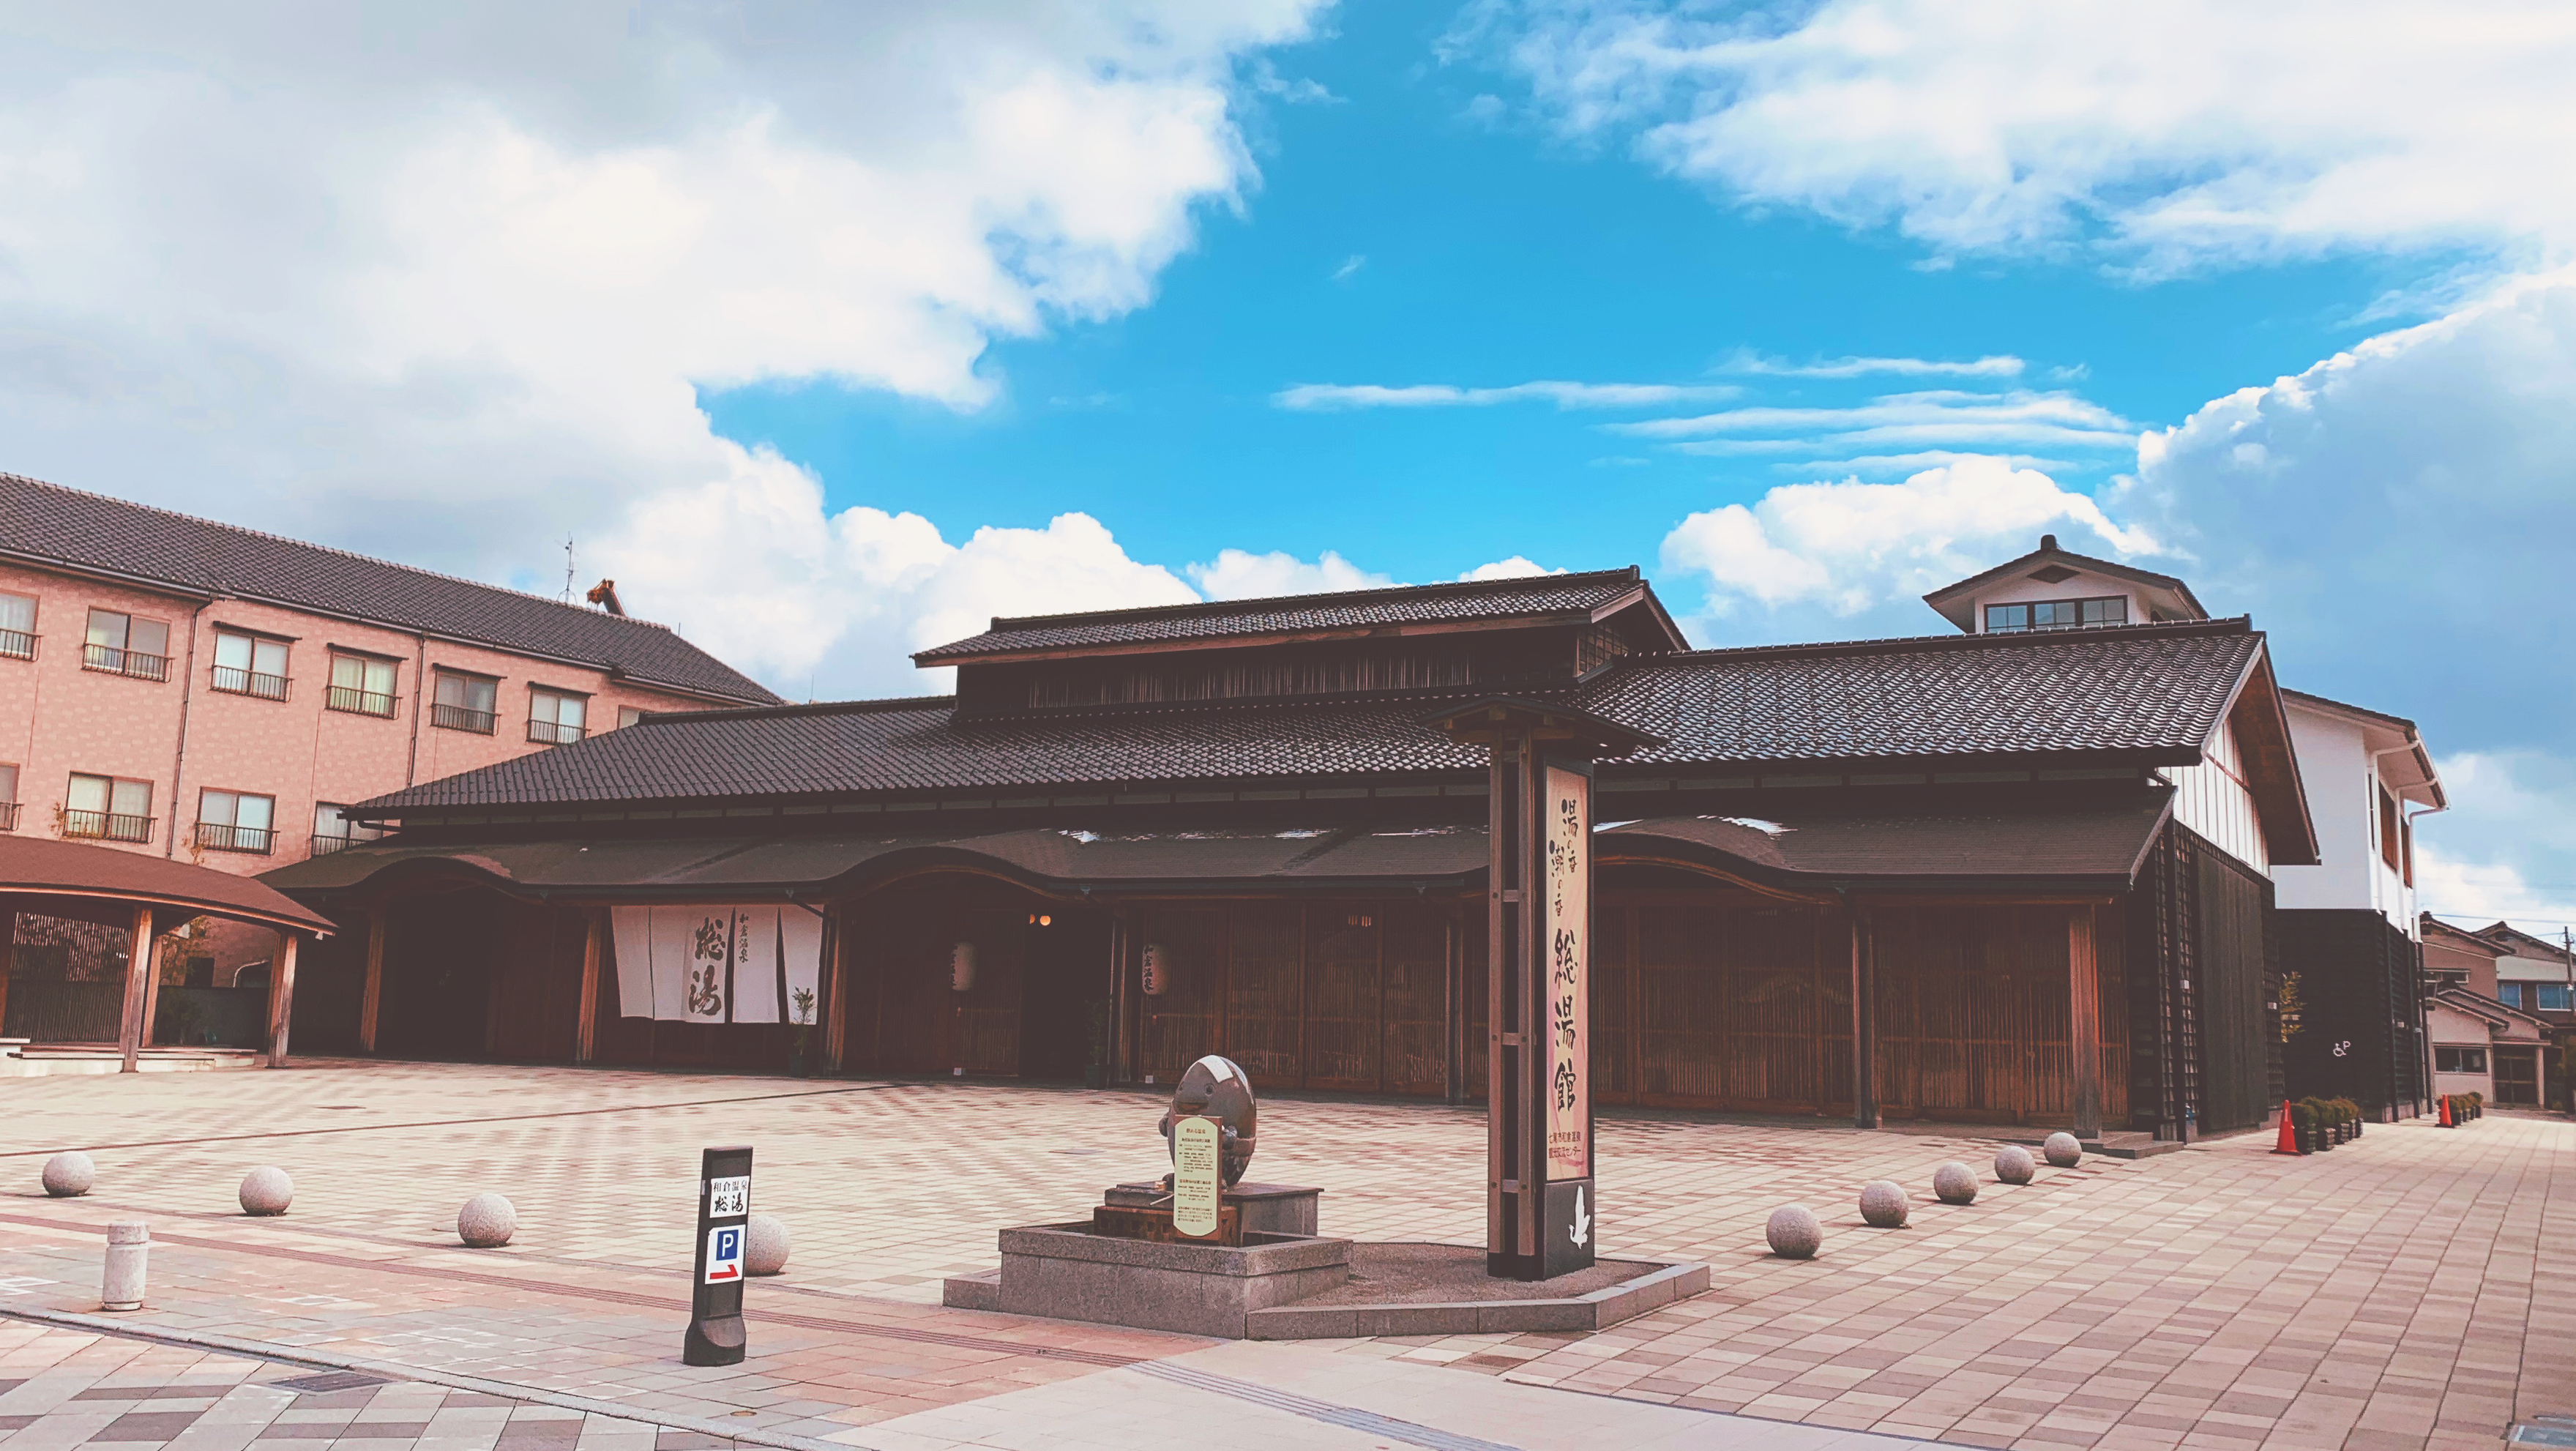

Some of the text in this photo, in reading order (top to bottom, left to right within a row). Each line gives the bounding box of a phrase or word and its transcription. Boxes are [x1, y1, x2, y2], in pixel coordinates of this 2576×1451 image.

[739, 913, 750, 964] 和倉温泉
[1554, 928, 1578, 1112] 総湯館
[2342, 1040, 2351, 1051] P
[713, 1179, 747, 1193] 和倉温泉
[722, 1233, 734, 1258] P
